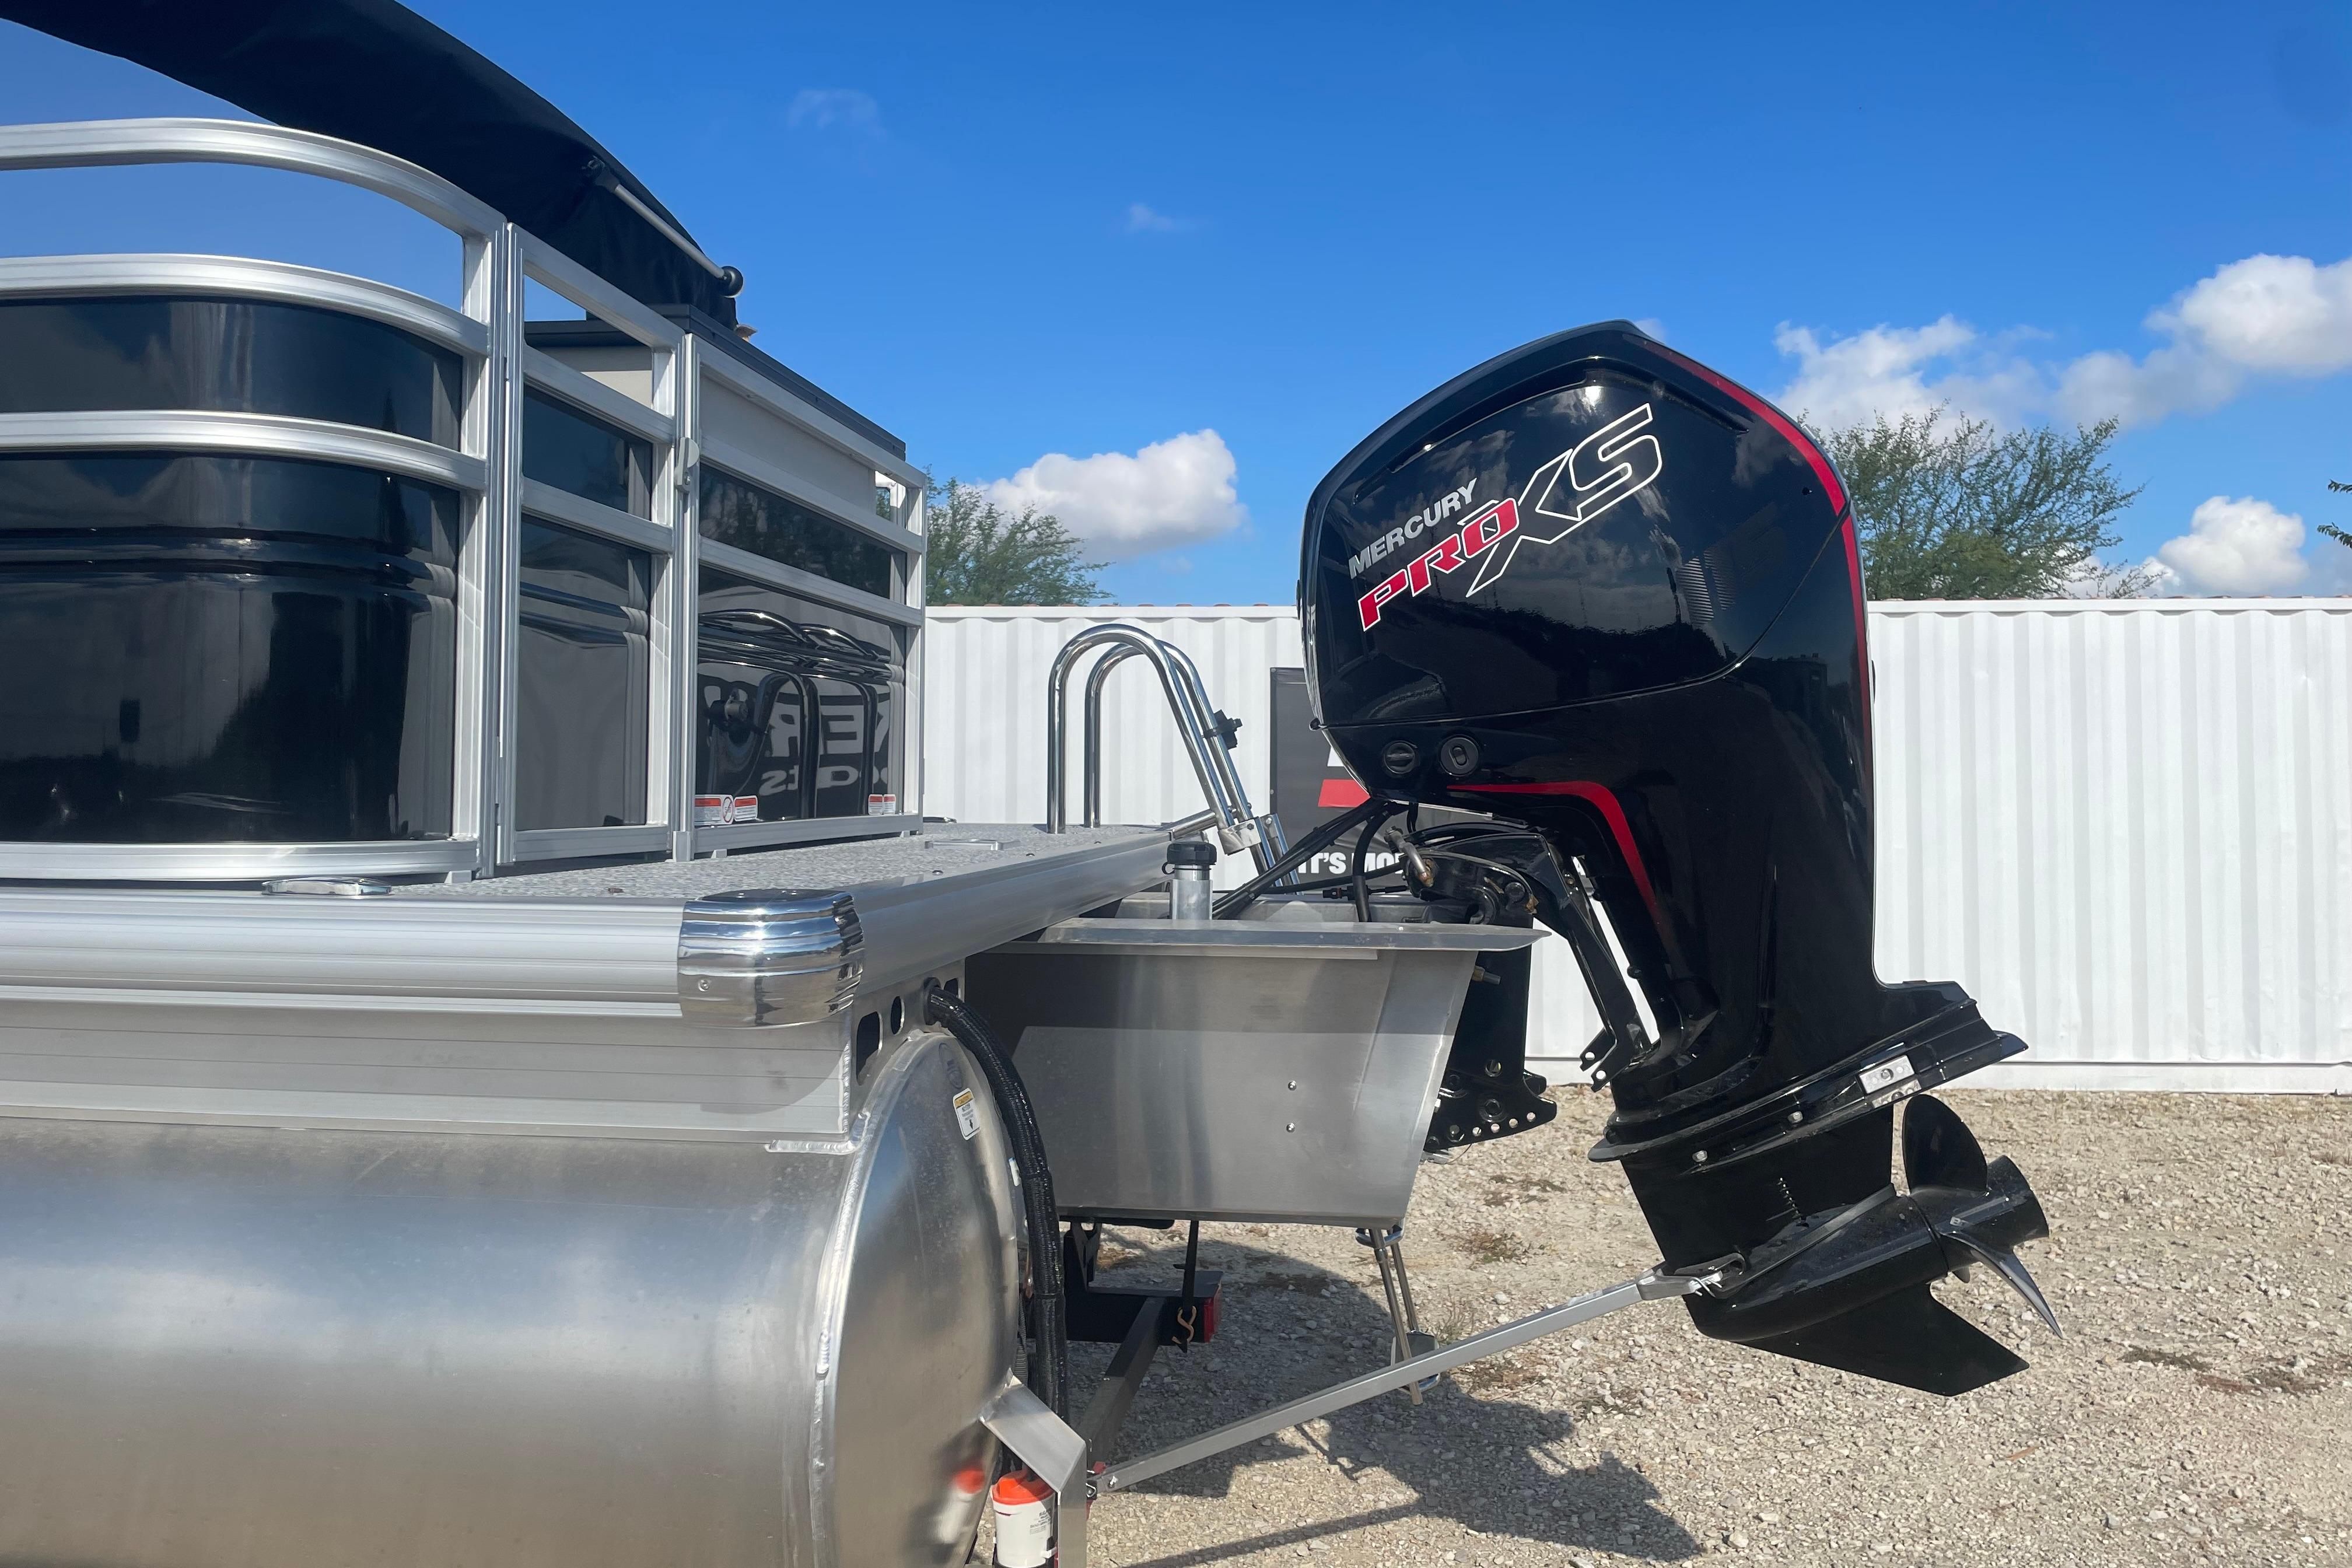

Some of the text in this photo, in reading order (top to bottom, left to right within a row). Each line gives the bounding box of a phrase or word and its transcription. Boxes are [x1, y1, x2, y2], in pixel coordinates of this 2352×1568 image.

[1348, 478, 1477, 580] MERCURY
[1357, 402, 1662, 632] PRO XS
